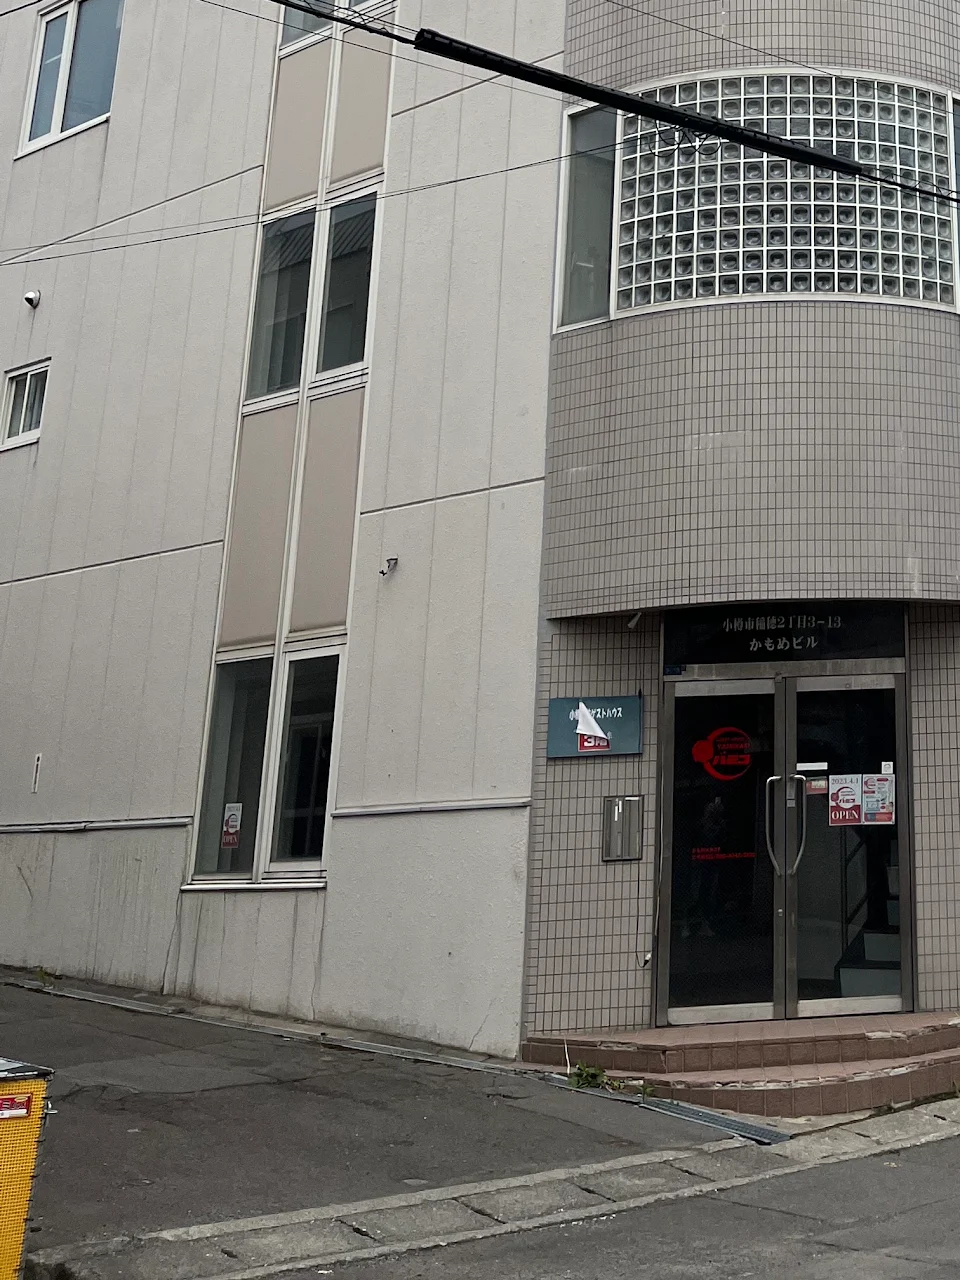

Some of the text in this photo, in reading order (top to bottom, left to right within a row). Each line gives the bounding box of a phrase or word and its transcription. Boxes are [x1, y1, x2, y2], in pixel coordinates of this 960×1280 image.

[749, 636, 819, 651] かもめビル
[831, 810, 859, 820] OPEN
